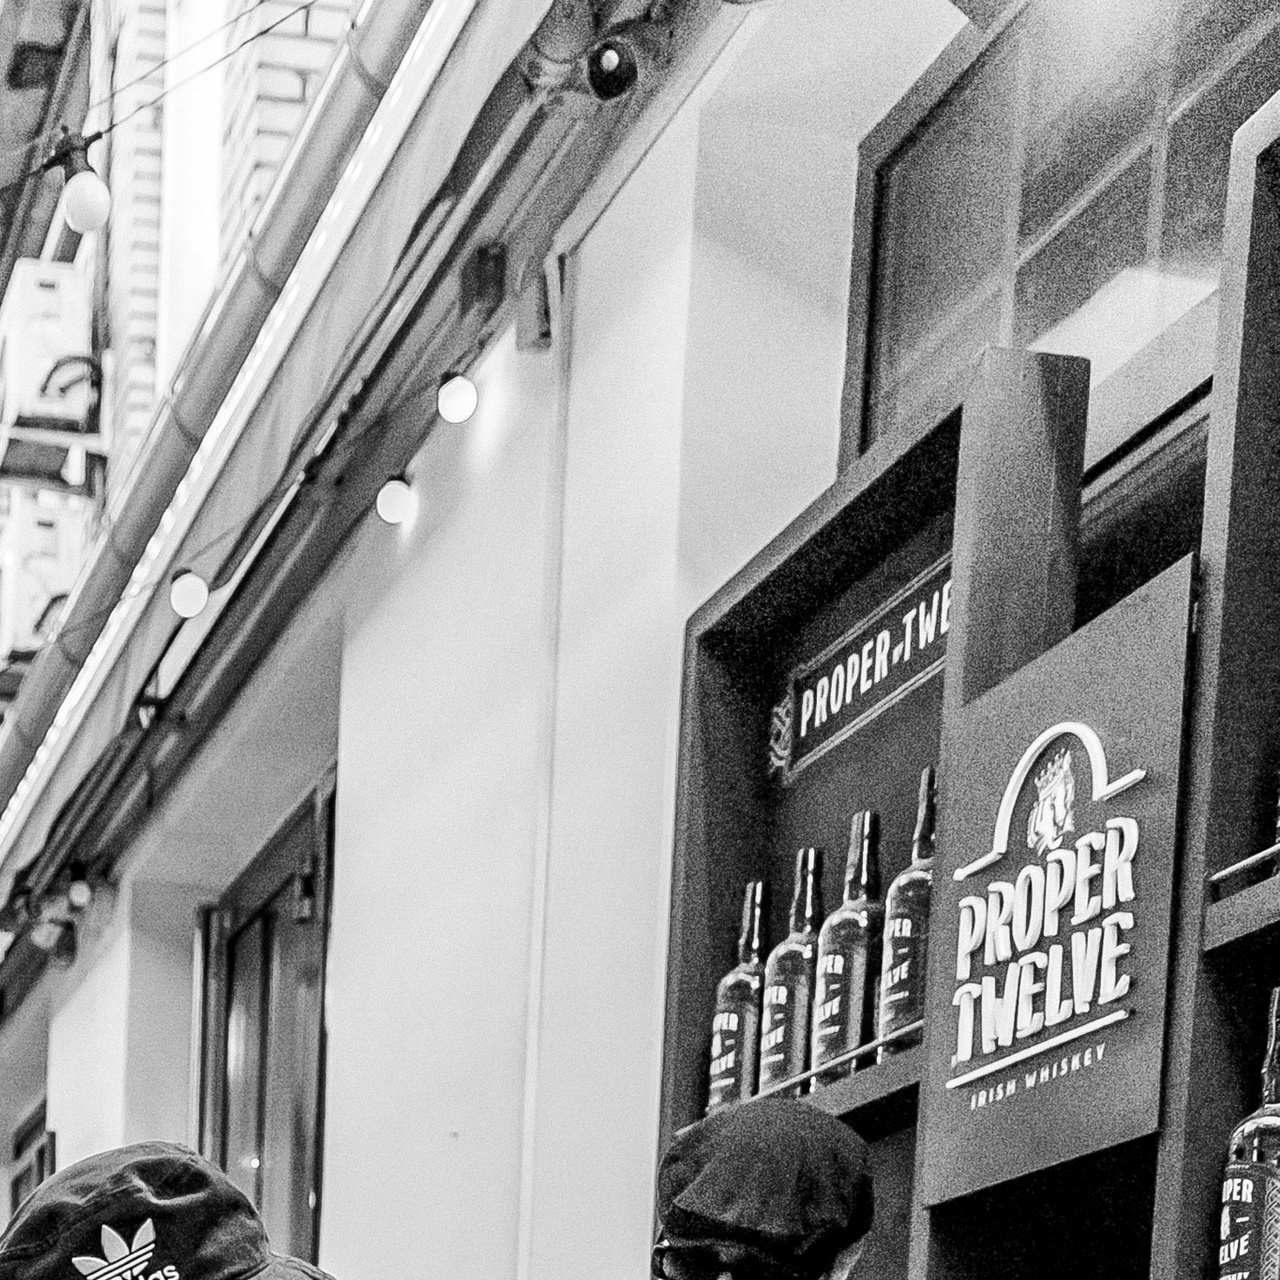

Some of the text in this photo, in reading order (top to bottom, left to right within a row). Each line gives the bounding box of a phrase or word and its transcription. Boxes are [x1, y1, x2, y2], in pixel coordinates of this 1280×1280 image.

[956, 816, 1139, 981] PROPER
[951, 911, 1135, 1066] TWELVE
[970, 1042, 1106, 1112] IRISH WHISKEY
